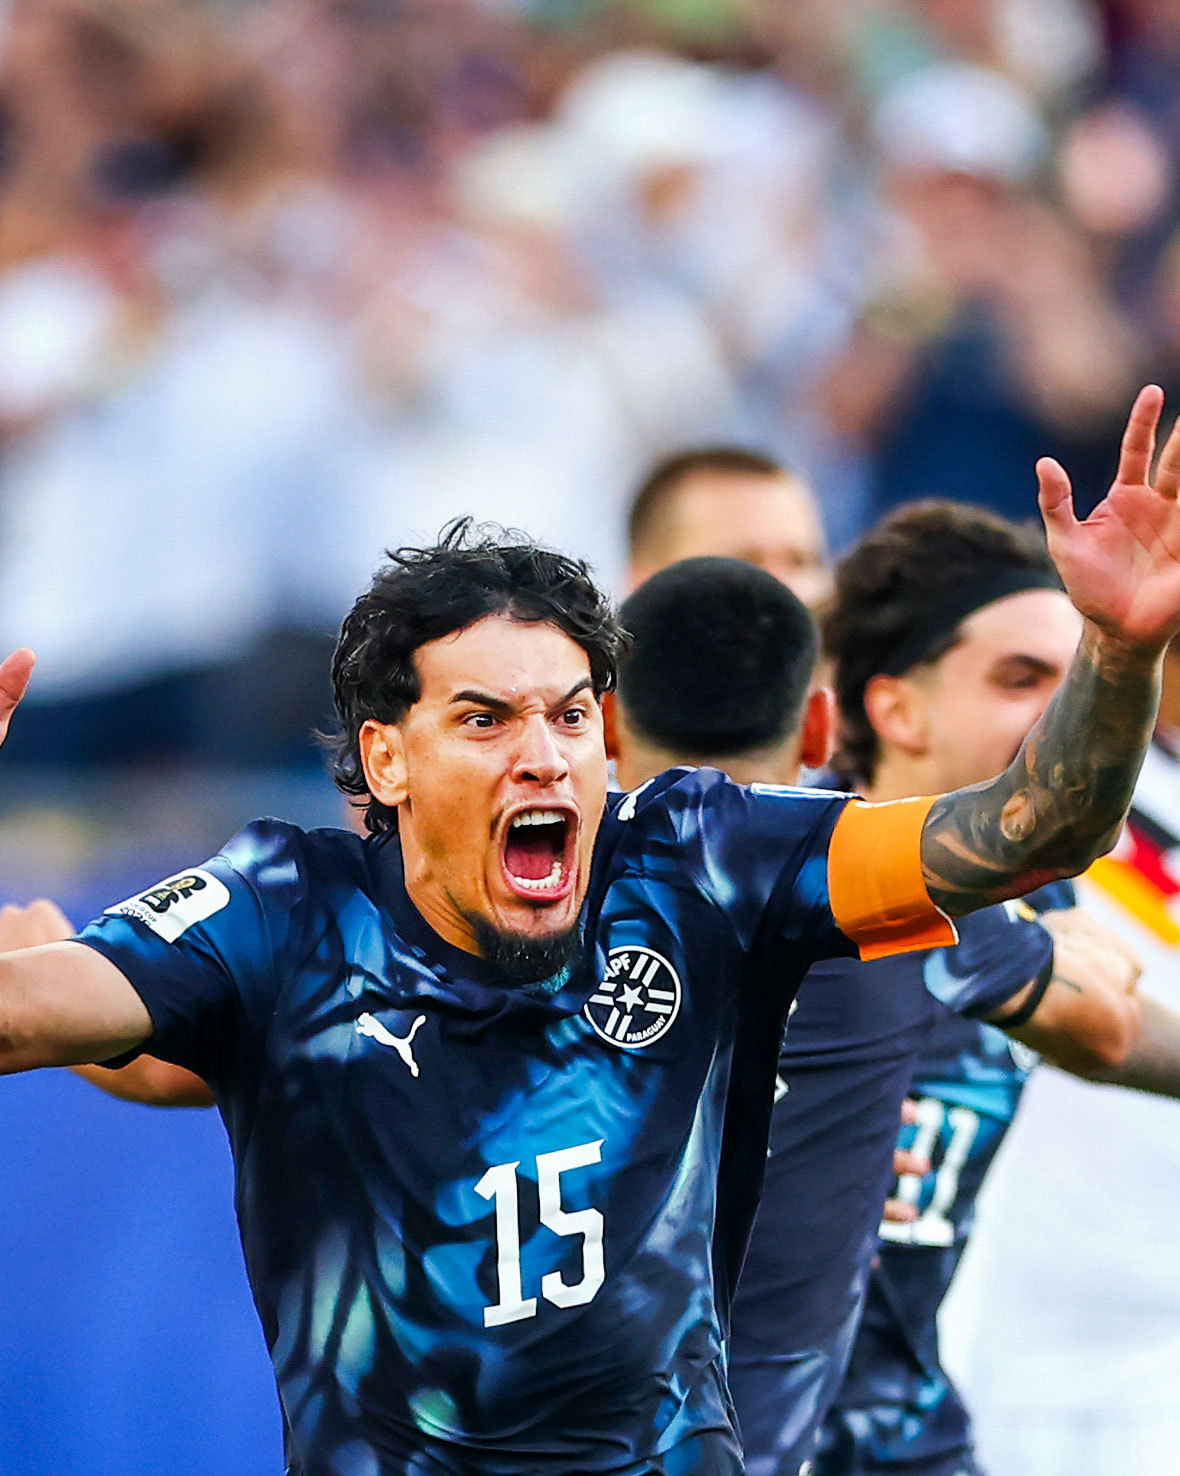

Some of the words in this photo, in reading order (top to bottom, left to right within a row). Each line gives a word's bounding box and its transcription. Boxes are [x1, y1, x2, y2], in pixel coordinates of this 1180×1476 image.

[603, 952, 631, 982] APF
[626, 1014, 667, 1042] PARAGUAY
[473, 1139, 606, 1328] 15
